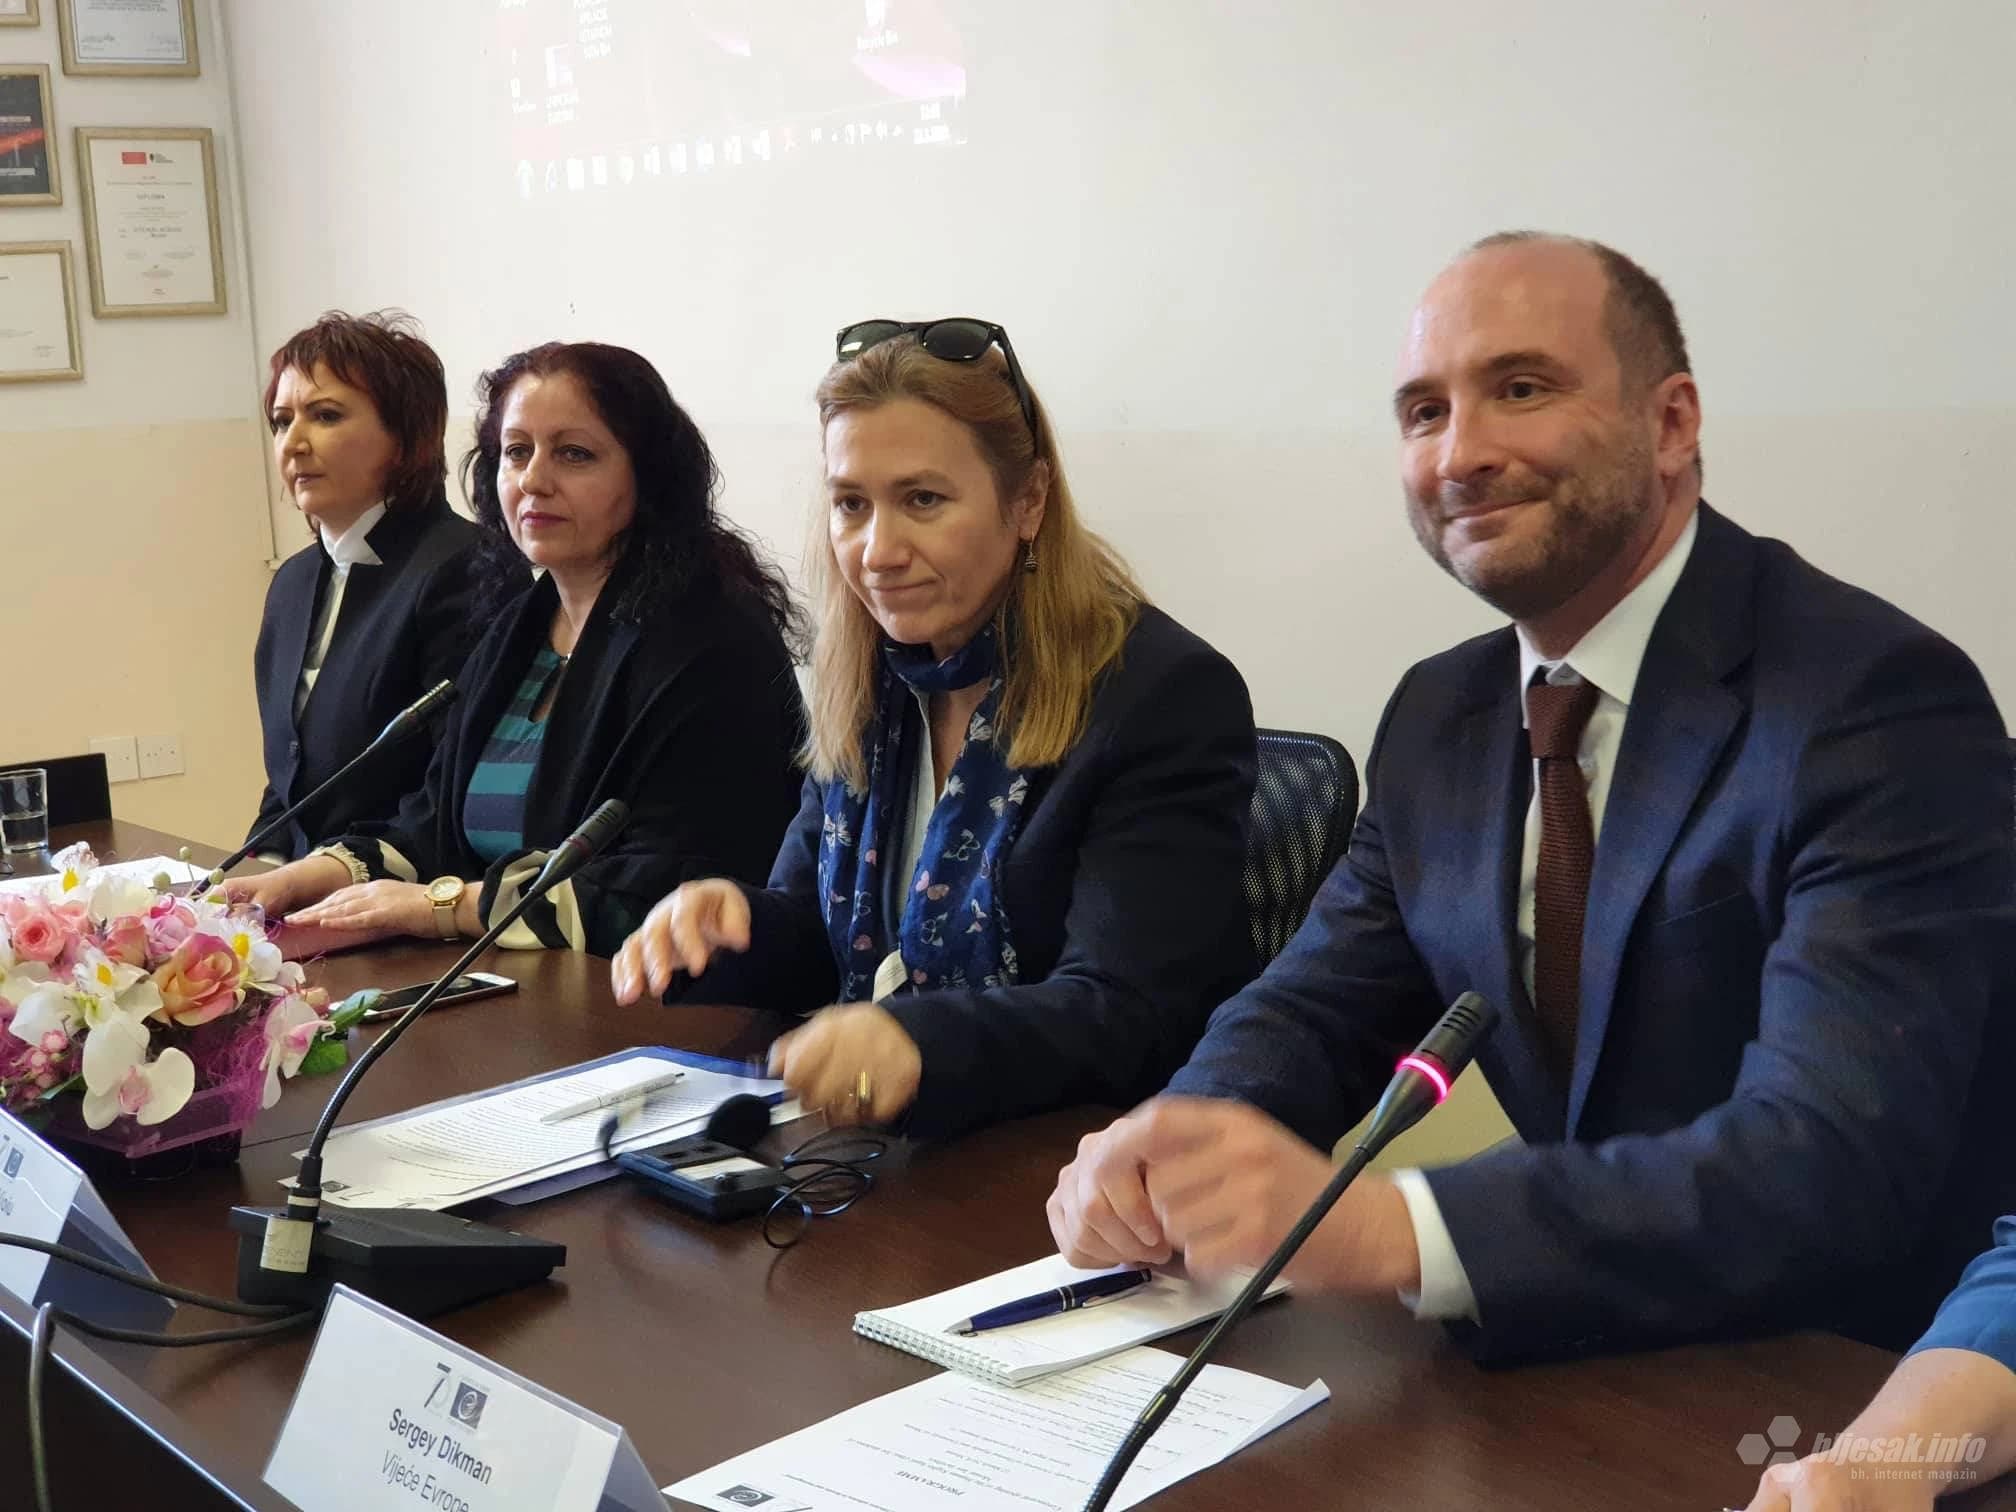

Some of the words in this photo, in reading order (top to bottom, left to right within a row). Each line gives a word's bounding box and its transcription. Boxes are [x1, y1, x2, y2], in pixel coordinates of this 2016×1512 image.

[382, 1449, 421, 1492] Vijeće
[389, 1408, 438, 1457] Sergey
[437, 1435, 493, 1485] Dikman
